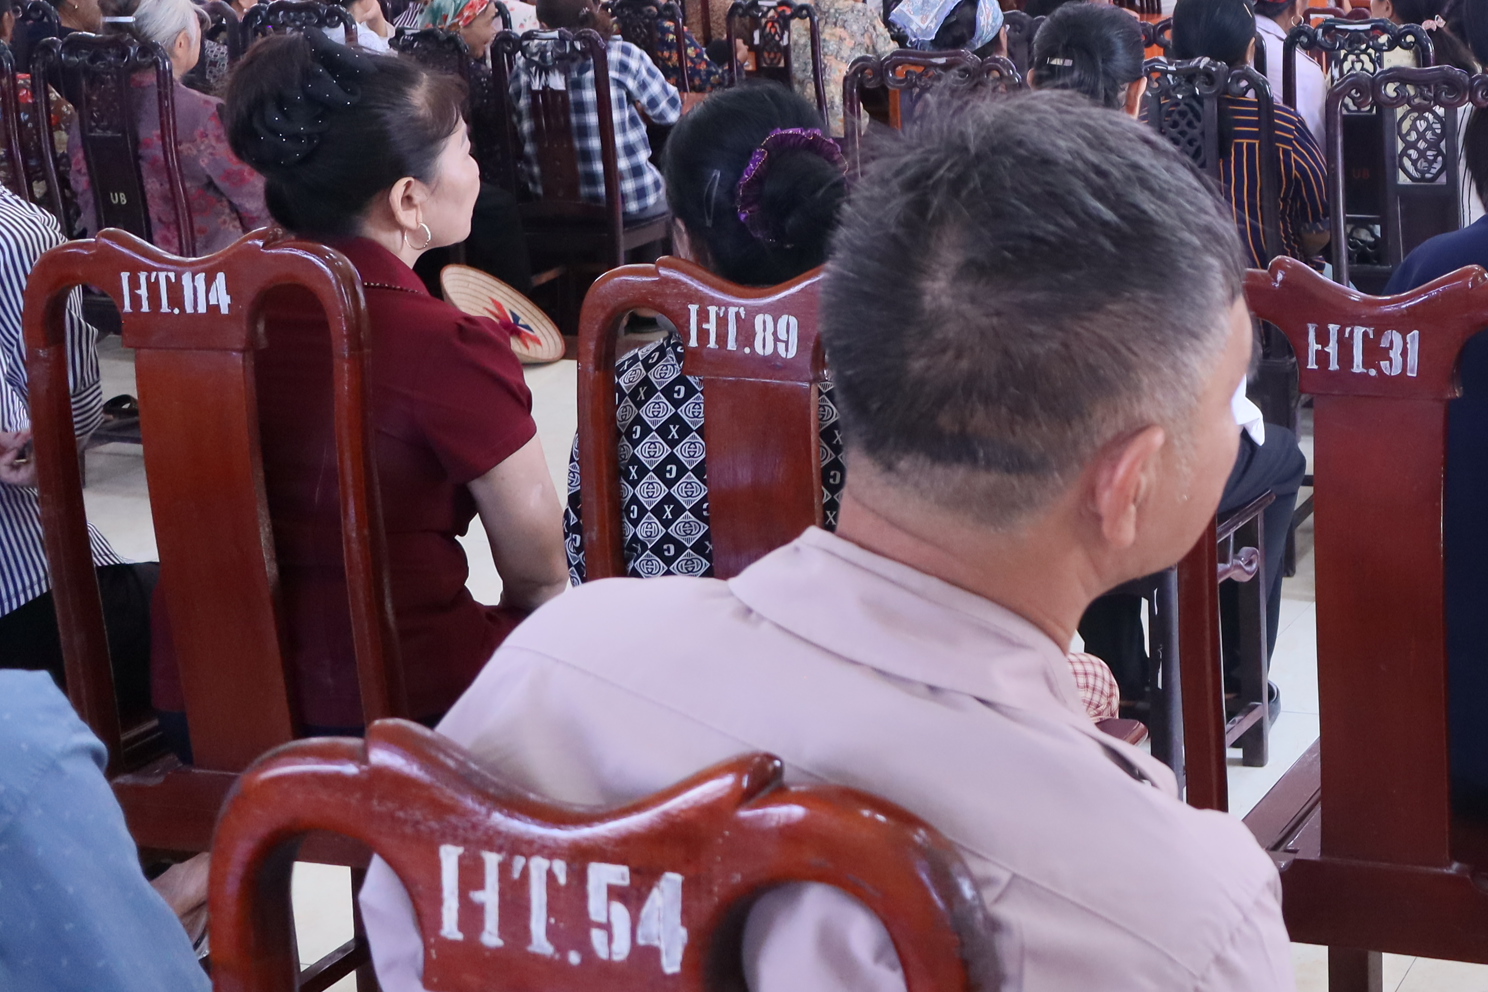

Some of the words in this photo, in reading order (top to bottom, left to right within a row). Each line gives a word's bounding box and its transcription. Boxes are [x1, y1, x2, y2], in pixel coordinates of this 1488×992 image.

[110, 192, 127, 205] UB
[120, 271, 231, 315] HT.114
[687, 304, 799, 359] HT.89
[1306, 322, 1420, 378] HT.31
[439, 844, 689, 975] HT.54
